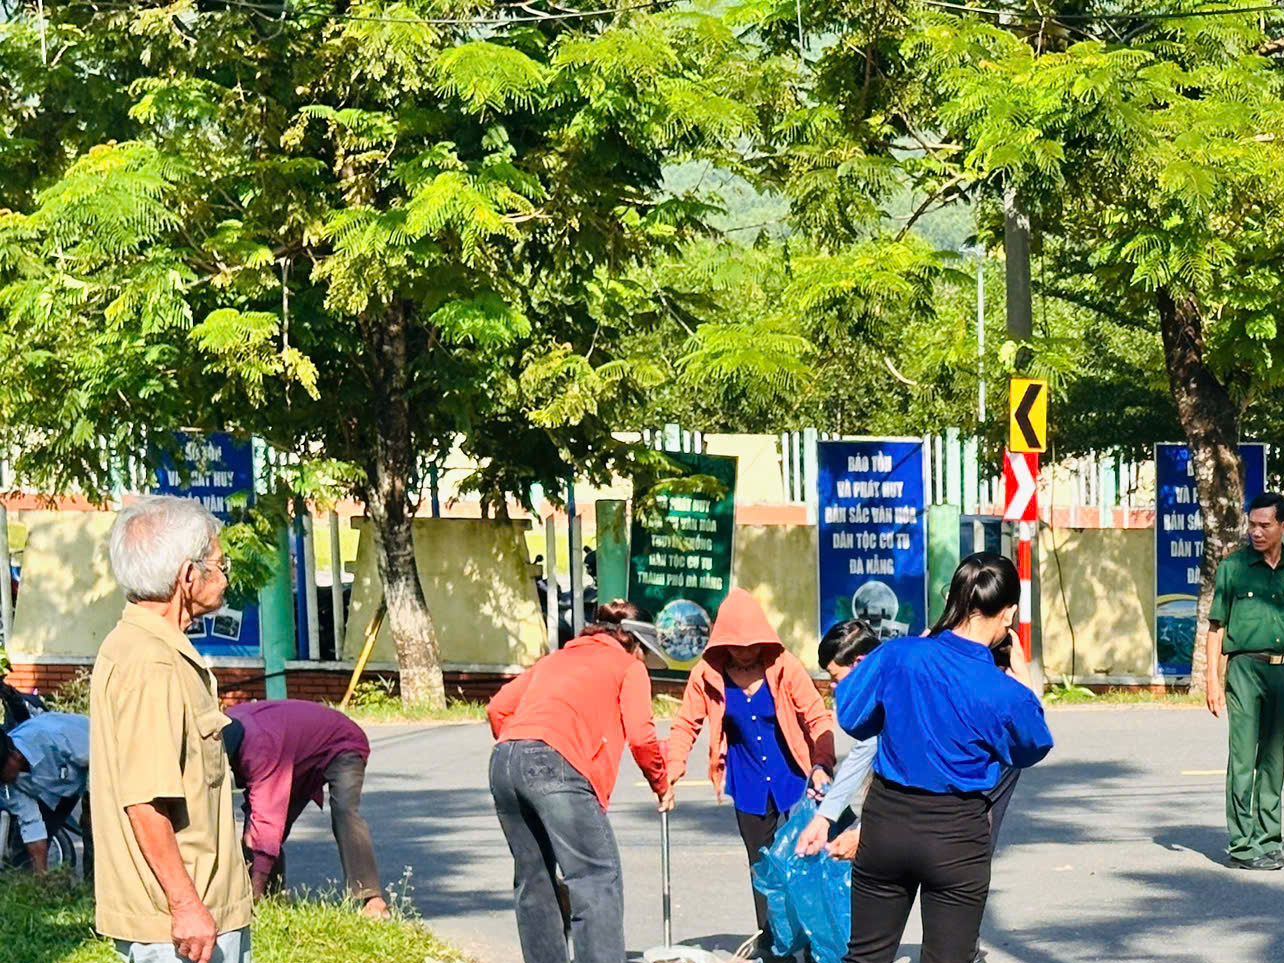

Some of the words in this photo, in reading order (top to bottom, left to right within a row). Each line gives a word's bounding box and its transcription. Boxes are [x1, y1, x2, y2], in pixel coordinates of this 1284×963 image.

[848, 452, 870, 472] BẢO
[213, 471, 234, 487] HUY
[837, 479, 852, 498] VÀ
[881, 481, 904, 498] HUY
[1175, 485, 1190, 504] VÀ
[849, 502, 869, 523] SẮC
[1163, 511, 1184, 531] BẢN
[1187, 510, 1204, 530] SẮ
[832, 530, 853, 549] DÂN
[856, 530, 877, 552] TỘC
[1170, 538, 1192, 557] DÂN
